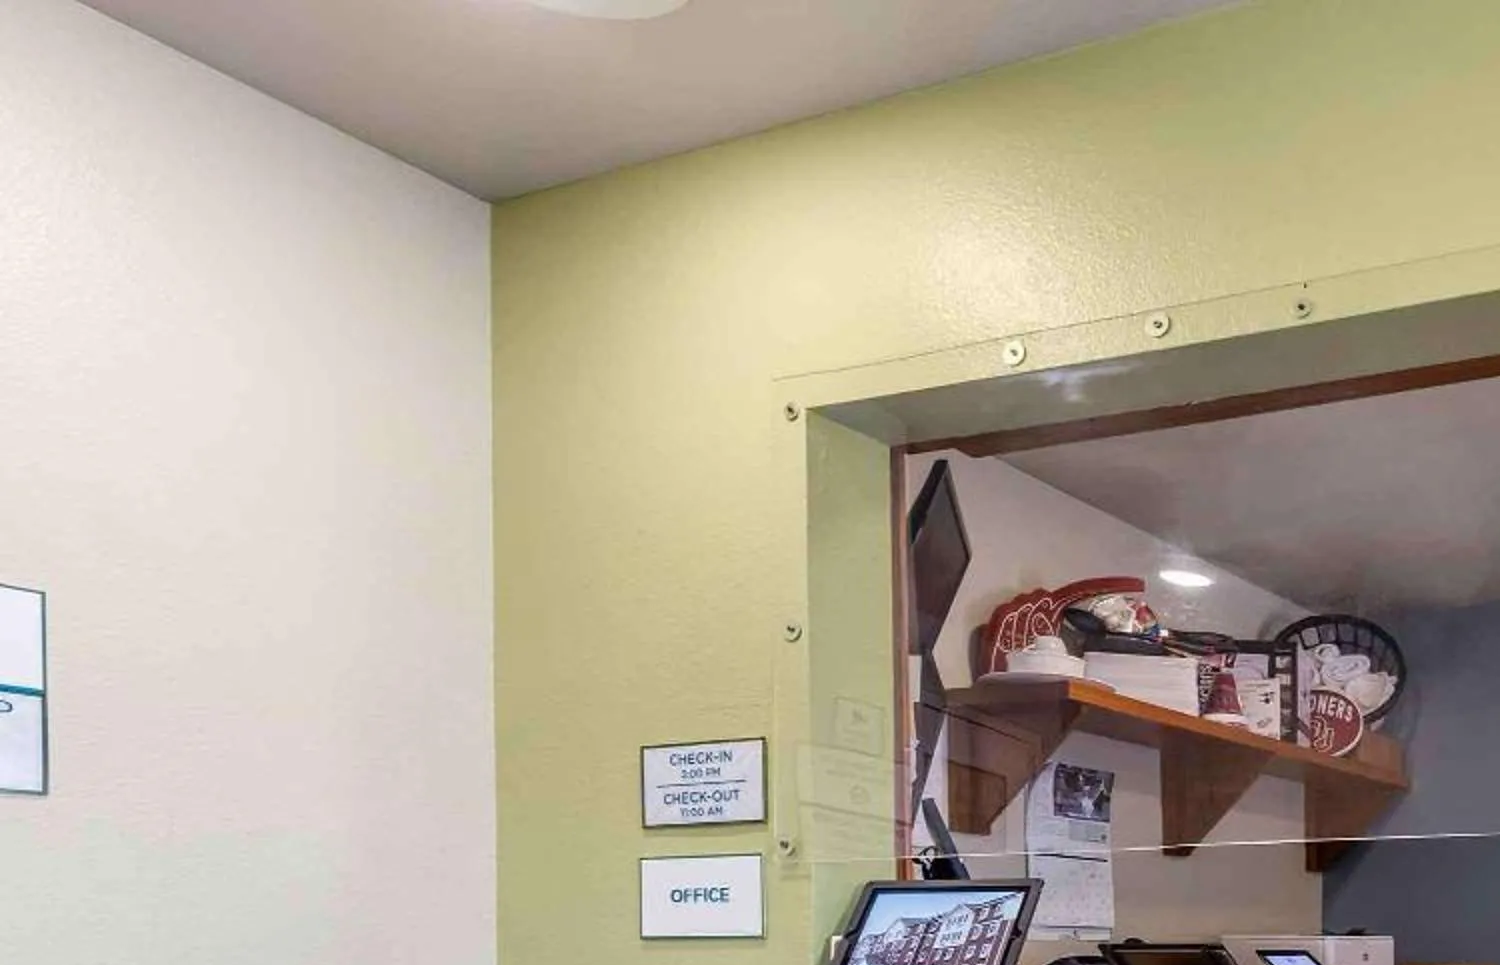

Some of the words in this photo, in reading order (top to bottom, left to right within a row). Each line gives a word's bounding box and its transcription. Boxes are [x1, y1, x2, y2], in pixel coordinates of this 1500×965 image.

[669, 749, 733, 767] CHECK-IN
[706, 766, 721, 777] PM
[663, 789, 741, 805] CHECK-OUT
[680, 807, 705, 818] 11:00
[707, 805, 723, 816] AM
[671, 887, 729, 903] OFFICE
